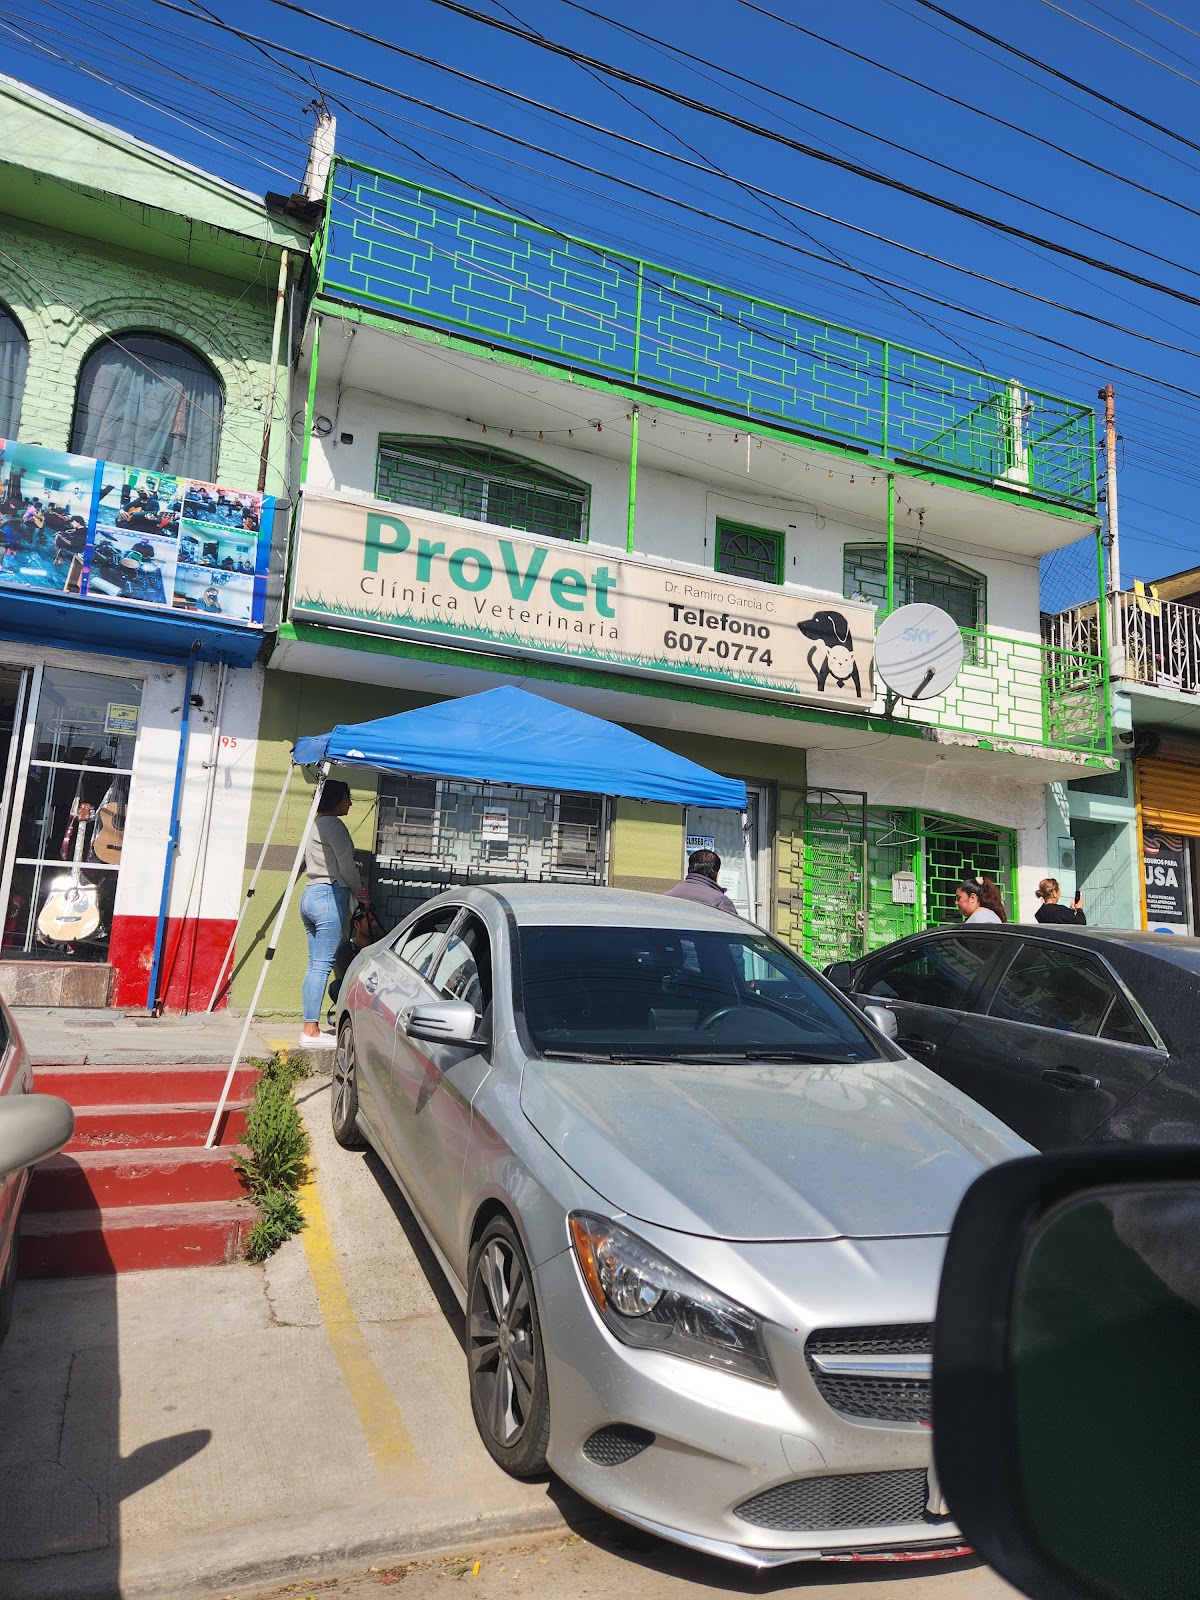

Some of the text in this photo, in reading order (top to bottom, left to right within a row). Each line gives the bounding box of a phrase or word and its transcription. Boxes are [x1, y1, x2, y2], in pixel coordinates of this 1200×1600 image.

[362, 512, 617, 618] ProVet
[360, 576, 619, 640] Clínica Veterinaria
[664, 581, 680, 594] Dr.
[684, 585, 724, 603] Ramiro
[765, 602, 777, 614] C.
[668, 603, 771, 640] Telefono
[901, 627, 939, 643] SKY
[663, 630, 773, 667] 607-0774
[1145, 865, 1179, 888] USA
